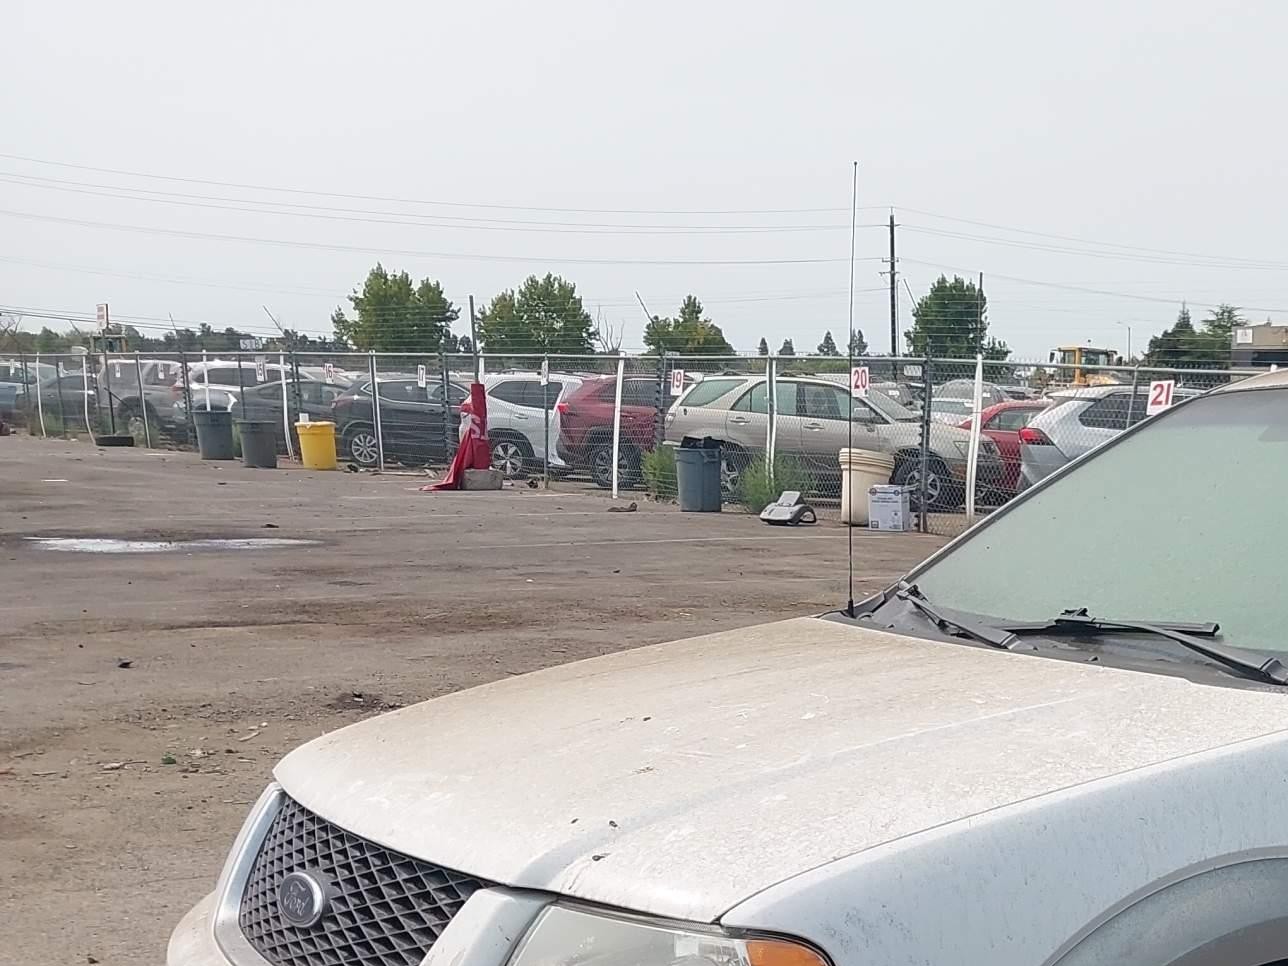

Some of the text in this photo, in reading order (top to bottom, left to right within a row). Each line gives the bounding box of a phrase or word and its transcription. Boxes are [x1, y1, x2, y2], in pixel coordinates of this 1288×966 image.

[672, 371, 682, 389] 19
[853, 369, 867, 389] 20
[1150, 383, 1172, 406] 21
